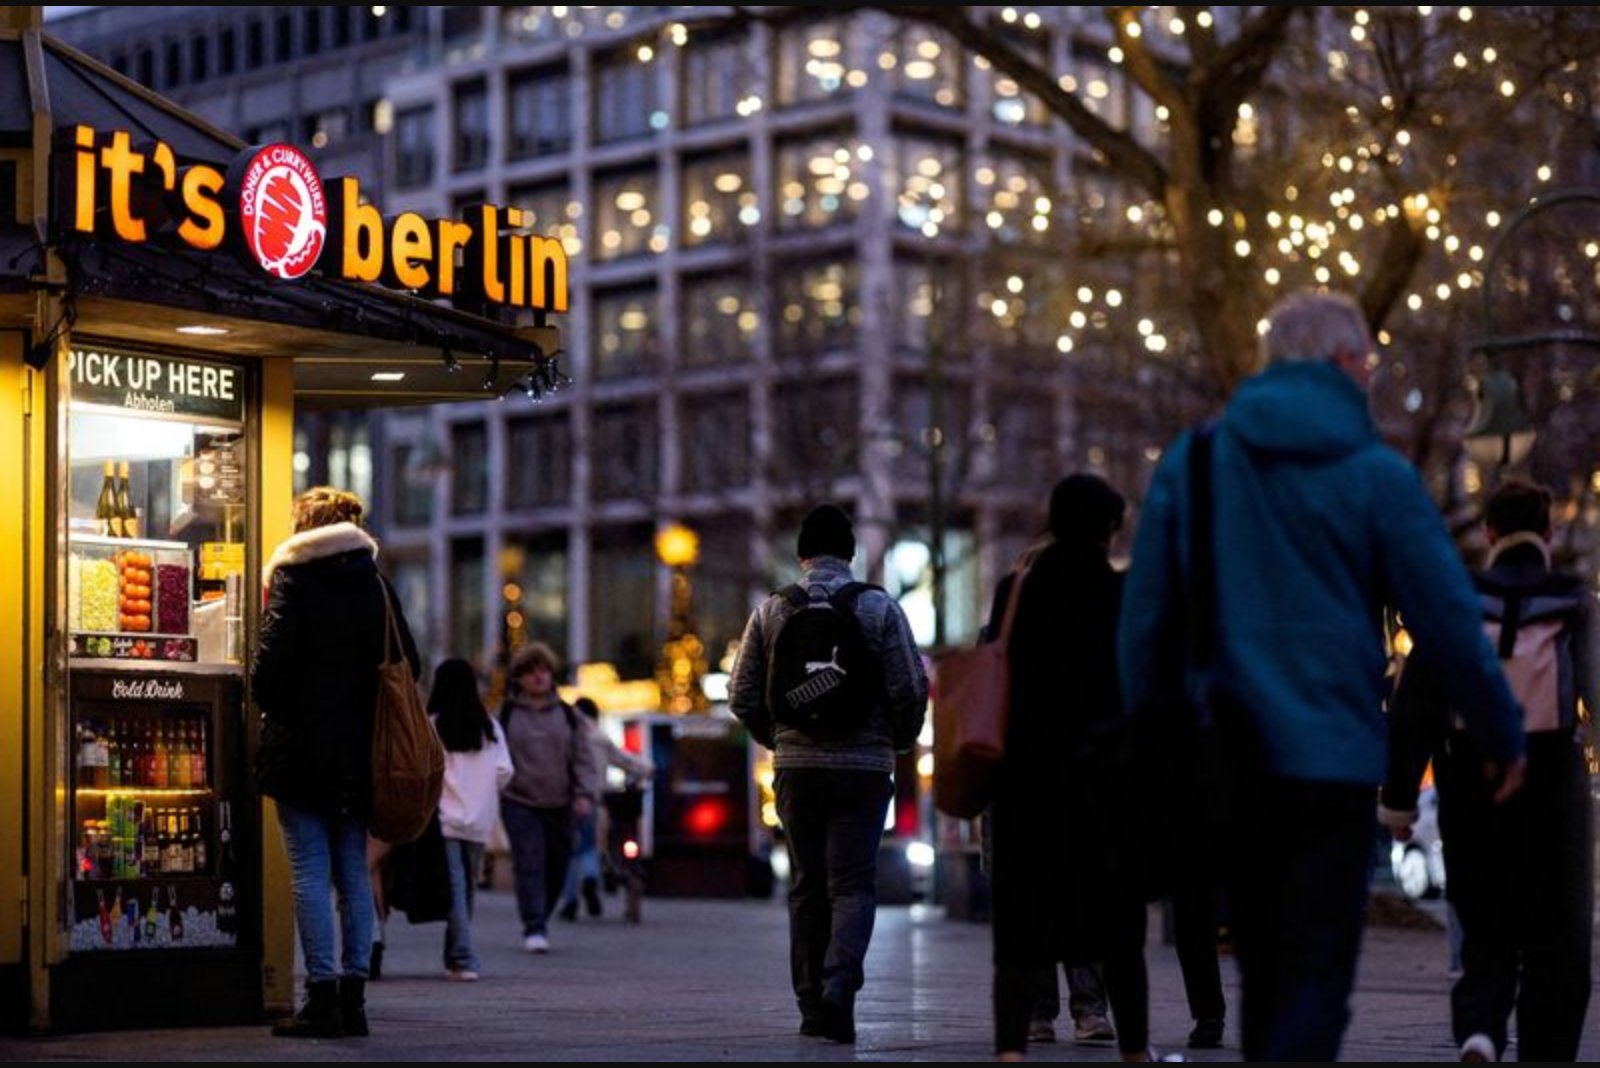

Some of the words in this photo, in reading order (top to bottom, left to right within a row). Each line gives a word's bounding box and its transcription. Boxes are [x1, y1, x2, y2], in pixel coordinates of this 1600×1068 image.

[75, 124, 227, 251] it's
[342, 176, 569, 312] berlin
[127, 357, 162, 391] UP
[168, 363, 235, 401] HERE
[124, 391, 175, 412] Abholen
[112, 680, 145, 699] Cold
[143, 679, 184, 699] Drink
